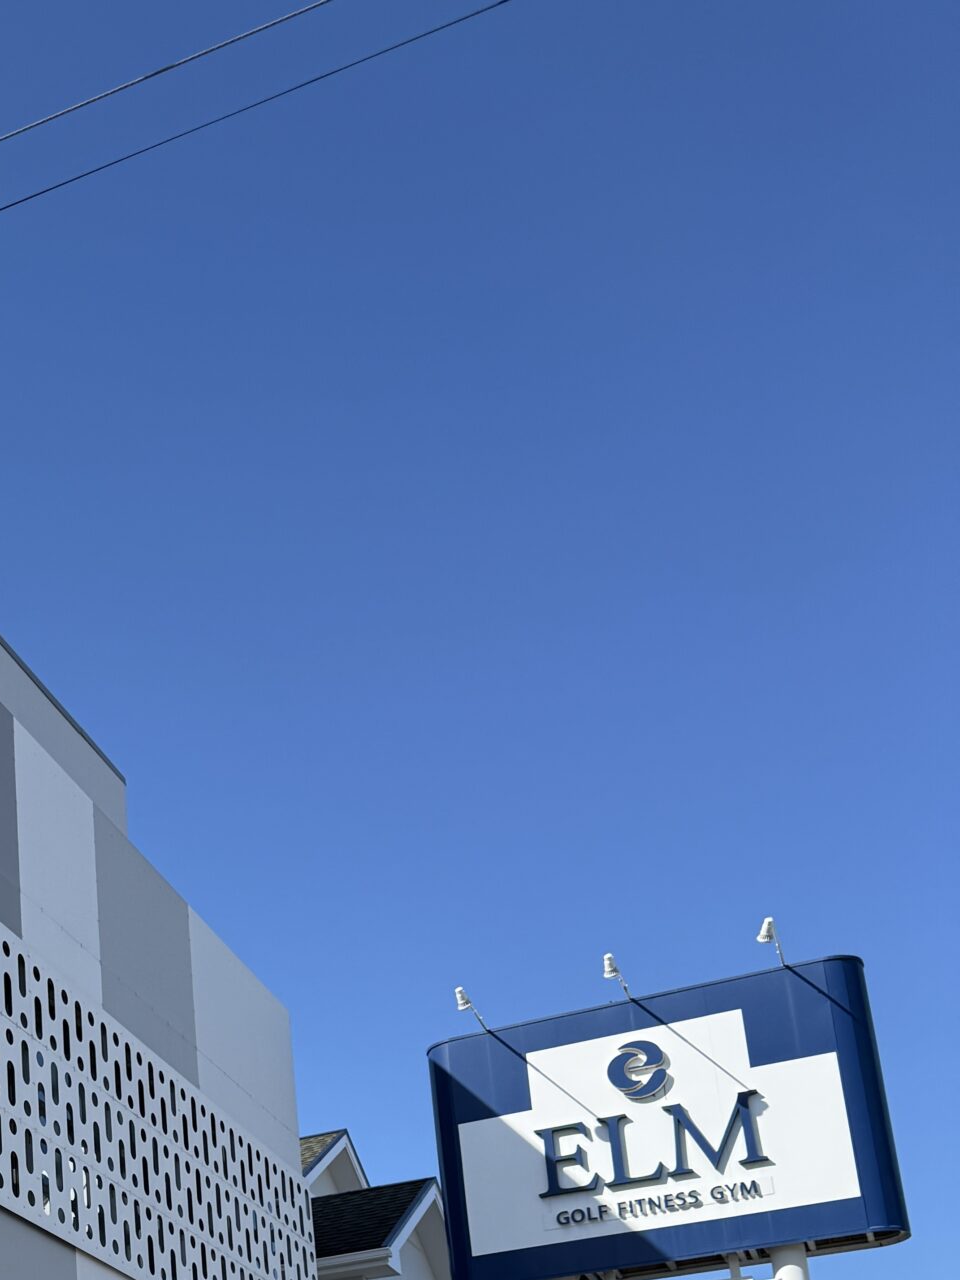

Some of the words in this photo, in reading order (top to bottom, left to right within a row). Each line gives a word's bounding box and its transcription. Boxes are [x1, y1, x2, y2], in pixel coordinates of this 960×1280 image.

[534, 1090, 770, 1199] ELM
[556, 1204, 610, 1226] GOLF
[618, 1190, 700, 1219] FITNESS
[711, 1179, 761, 1202] GYM
